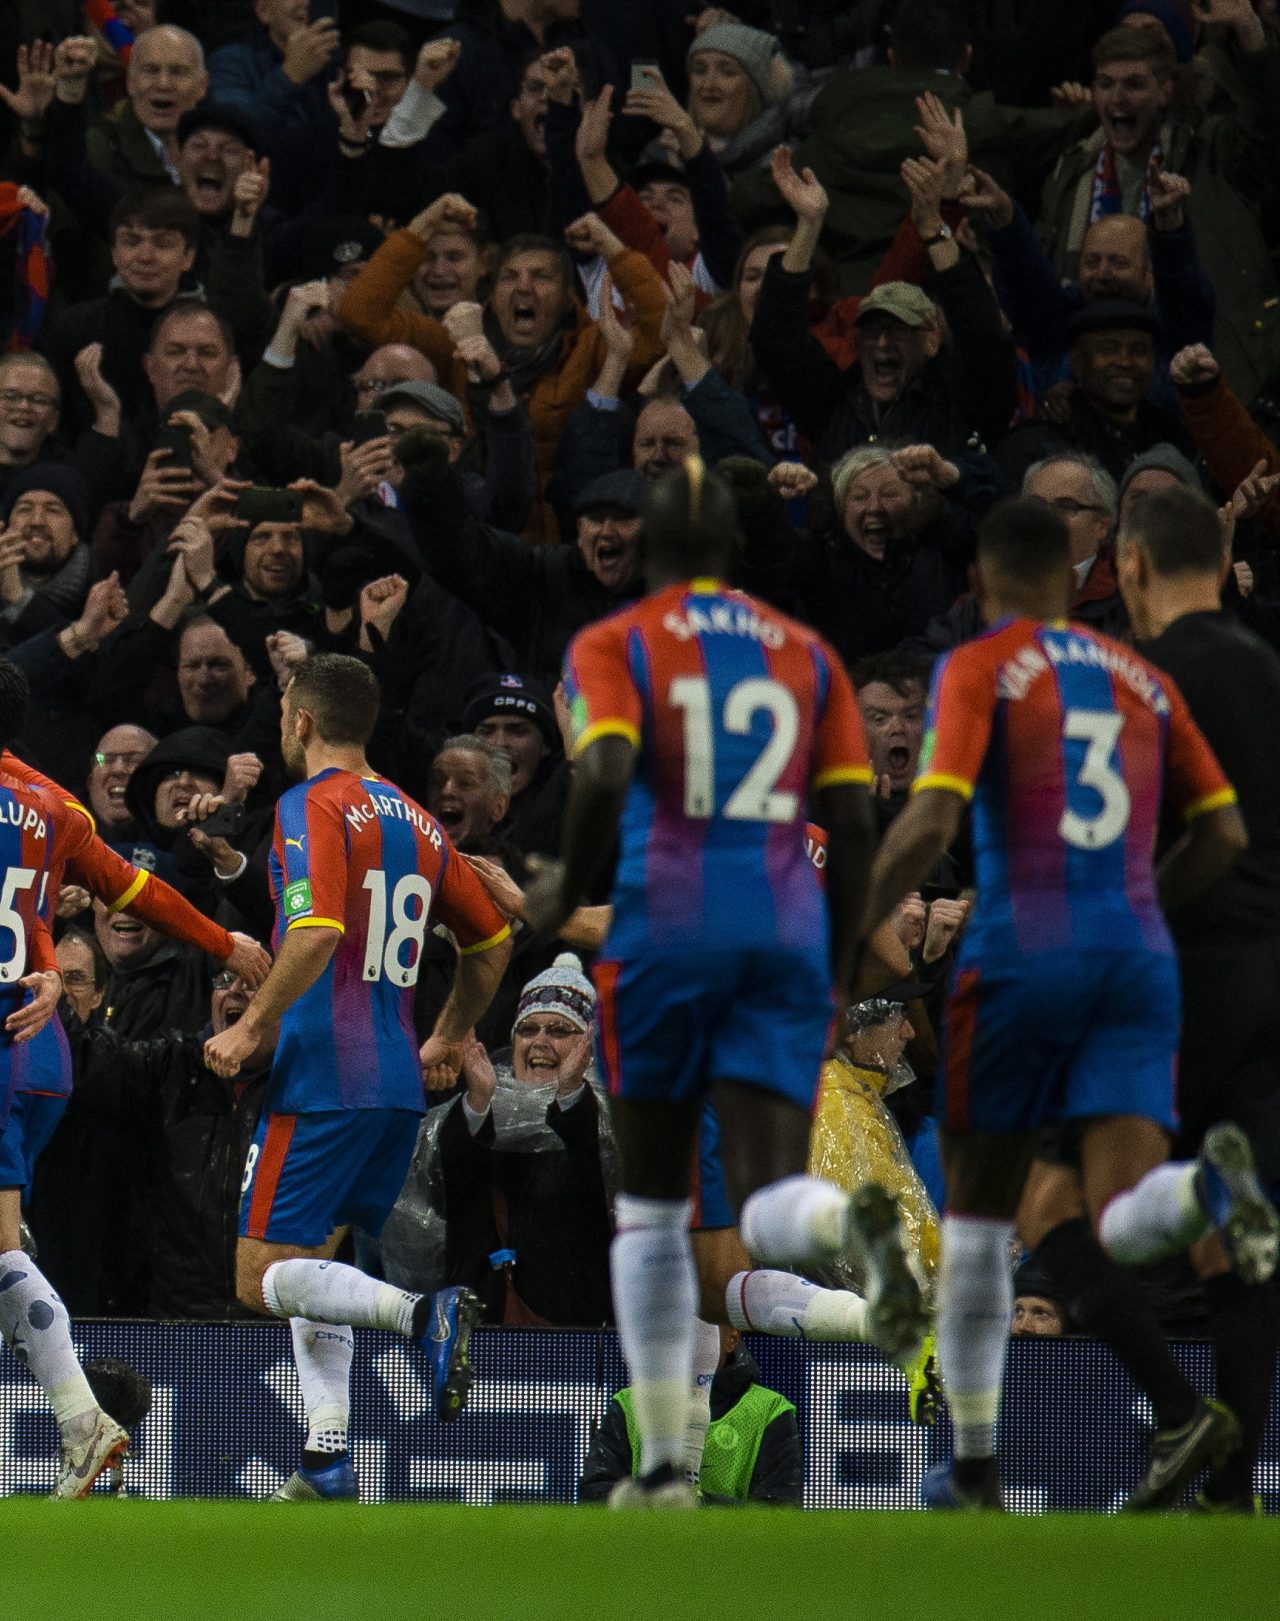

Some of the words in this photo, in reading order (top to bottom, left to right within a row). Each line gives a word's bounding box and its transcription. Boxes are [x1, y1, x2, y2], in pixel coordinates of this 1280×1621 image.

[669, 676, 800, 823] 12
[1058, 711, 1132, 849] 3
[346, 793, 444, 852] McARTHUR
[362, 869, 432, 988] 18
